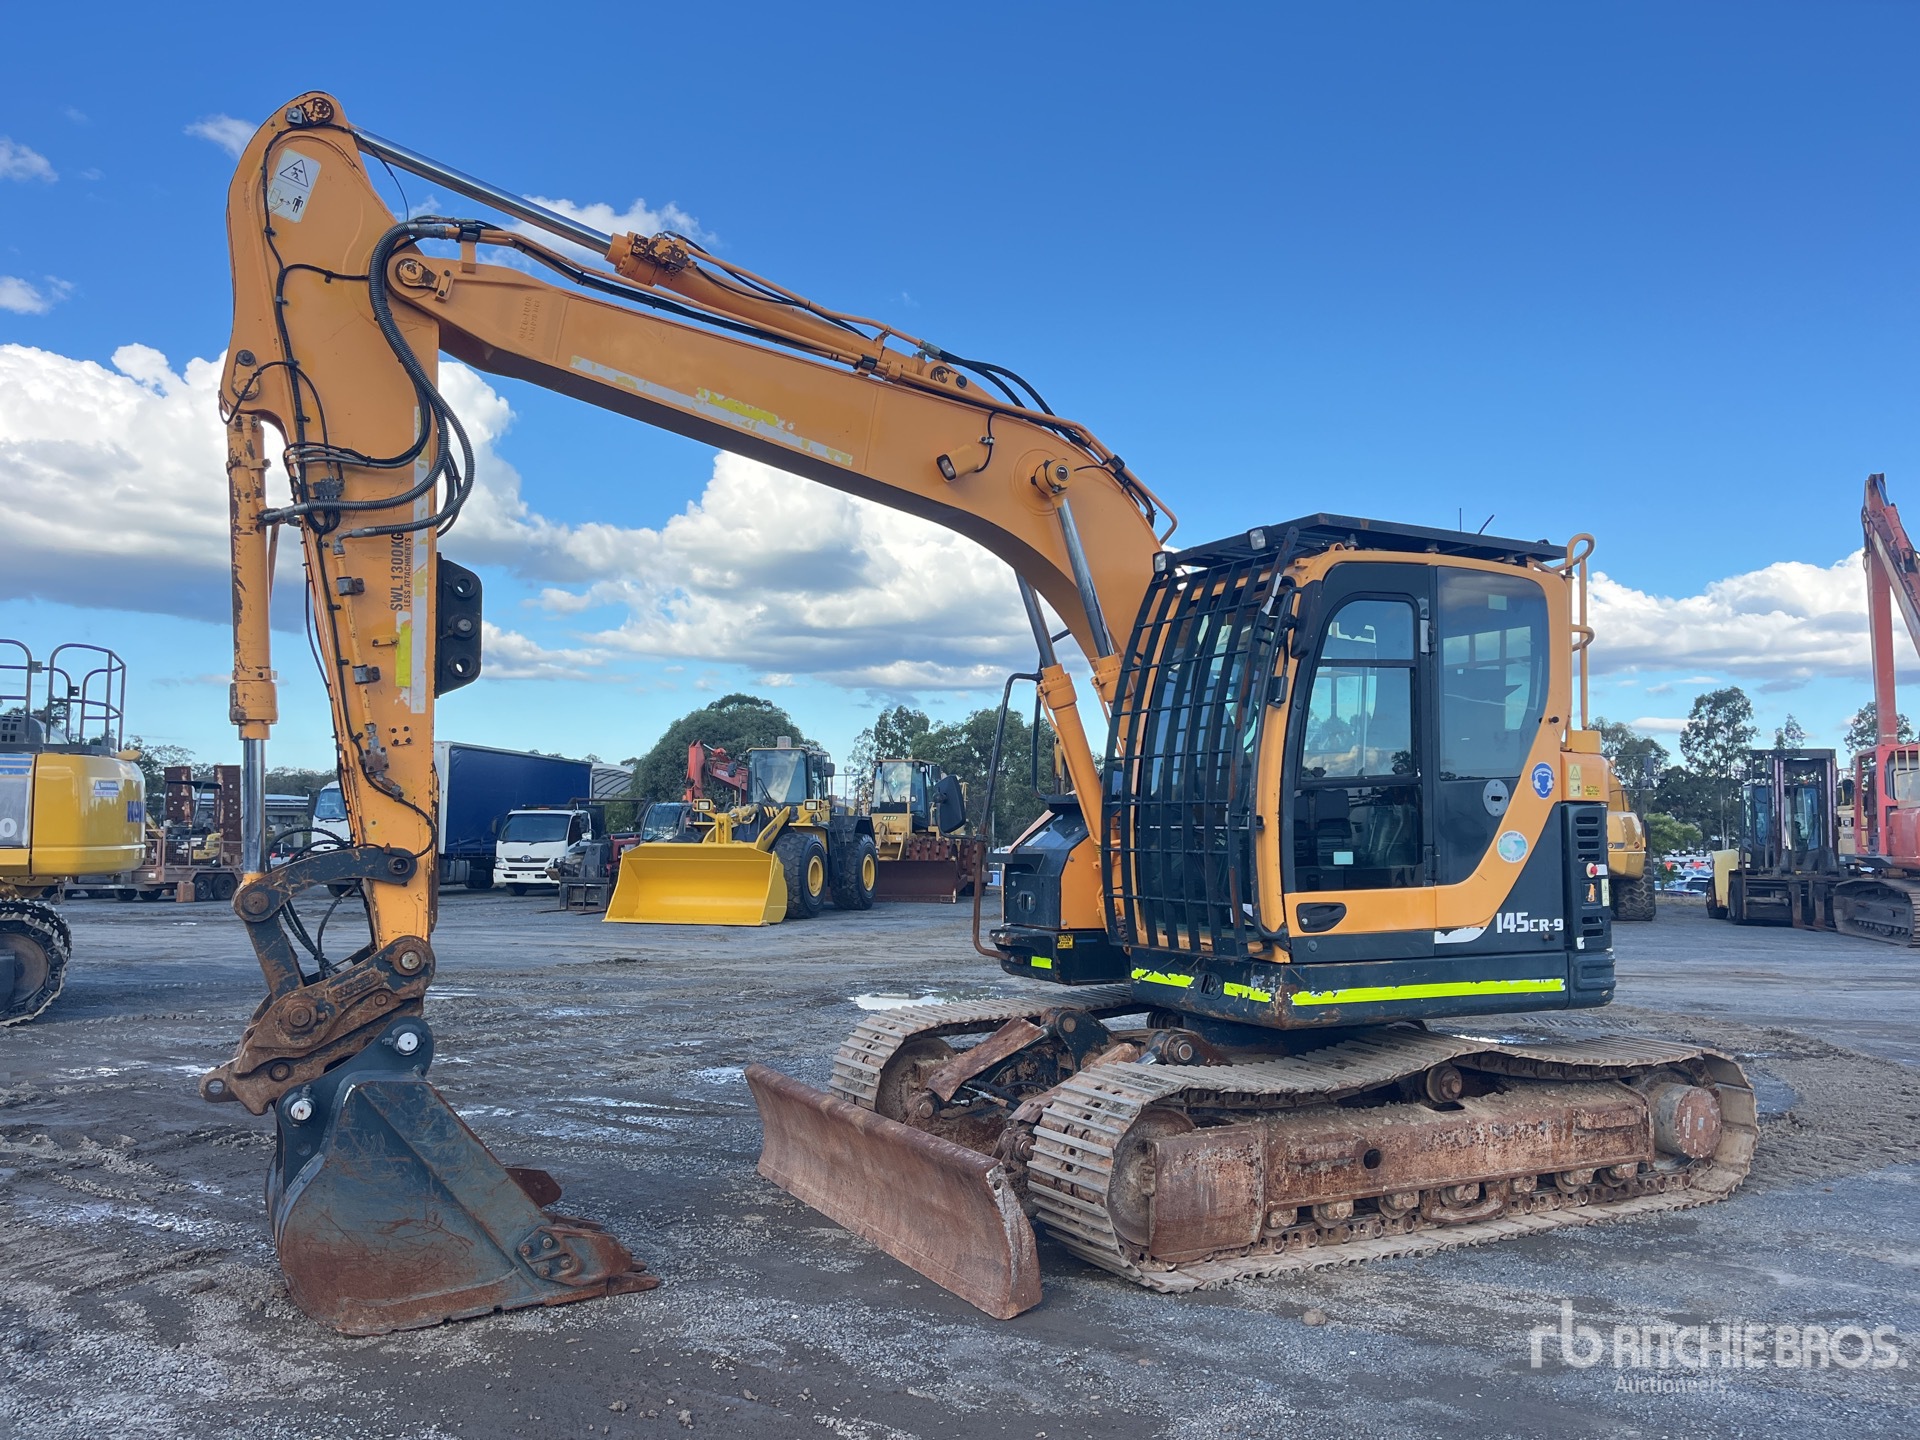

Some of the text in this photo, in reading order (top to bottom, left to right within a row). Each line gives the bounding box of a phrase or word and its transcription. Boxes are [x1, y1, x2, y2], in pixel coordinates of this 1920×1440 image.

[390, 532, 404, 611] SWL 1300KG
[404, 537, 412, 588] ATTACHMENTS
